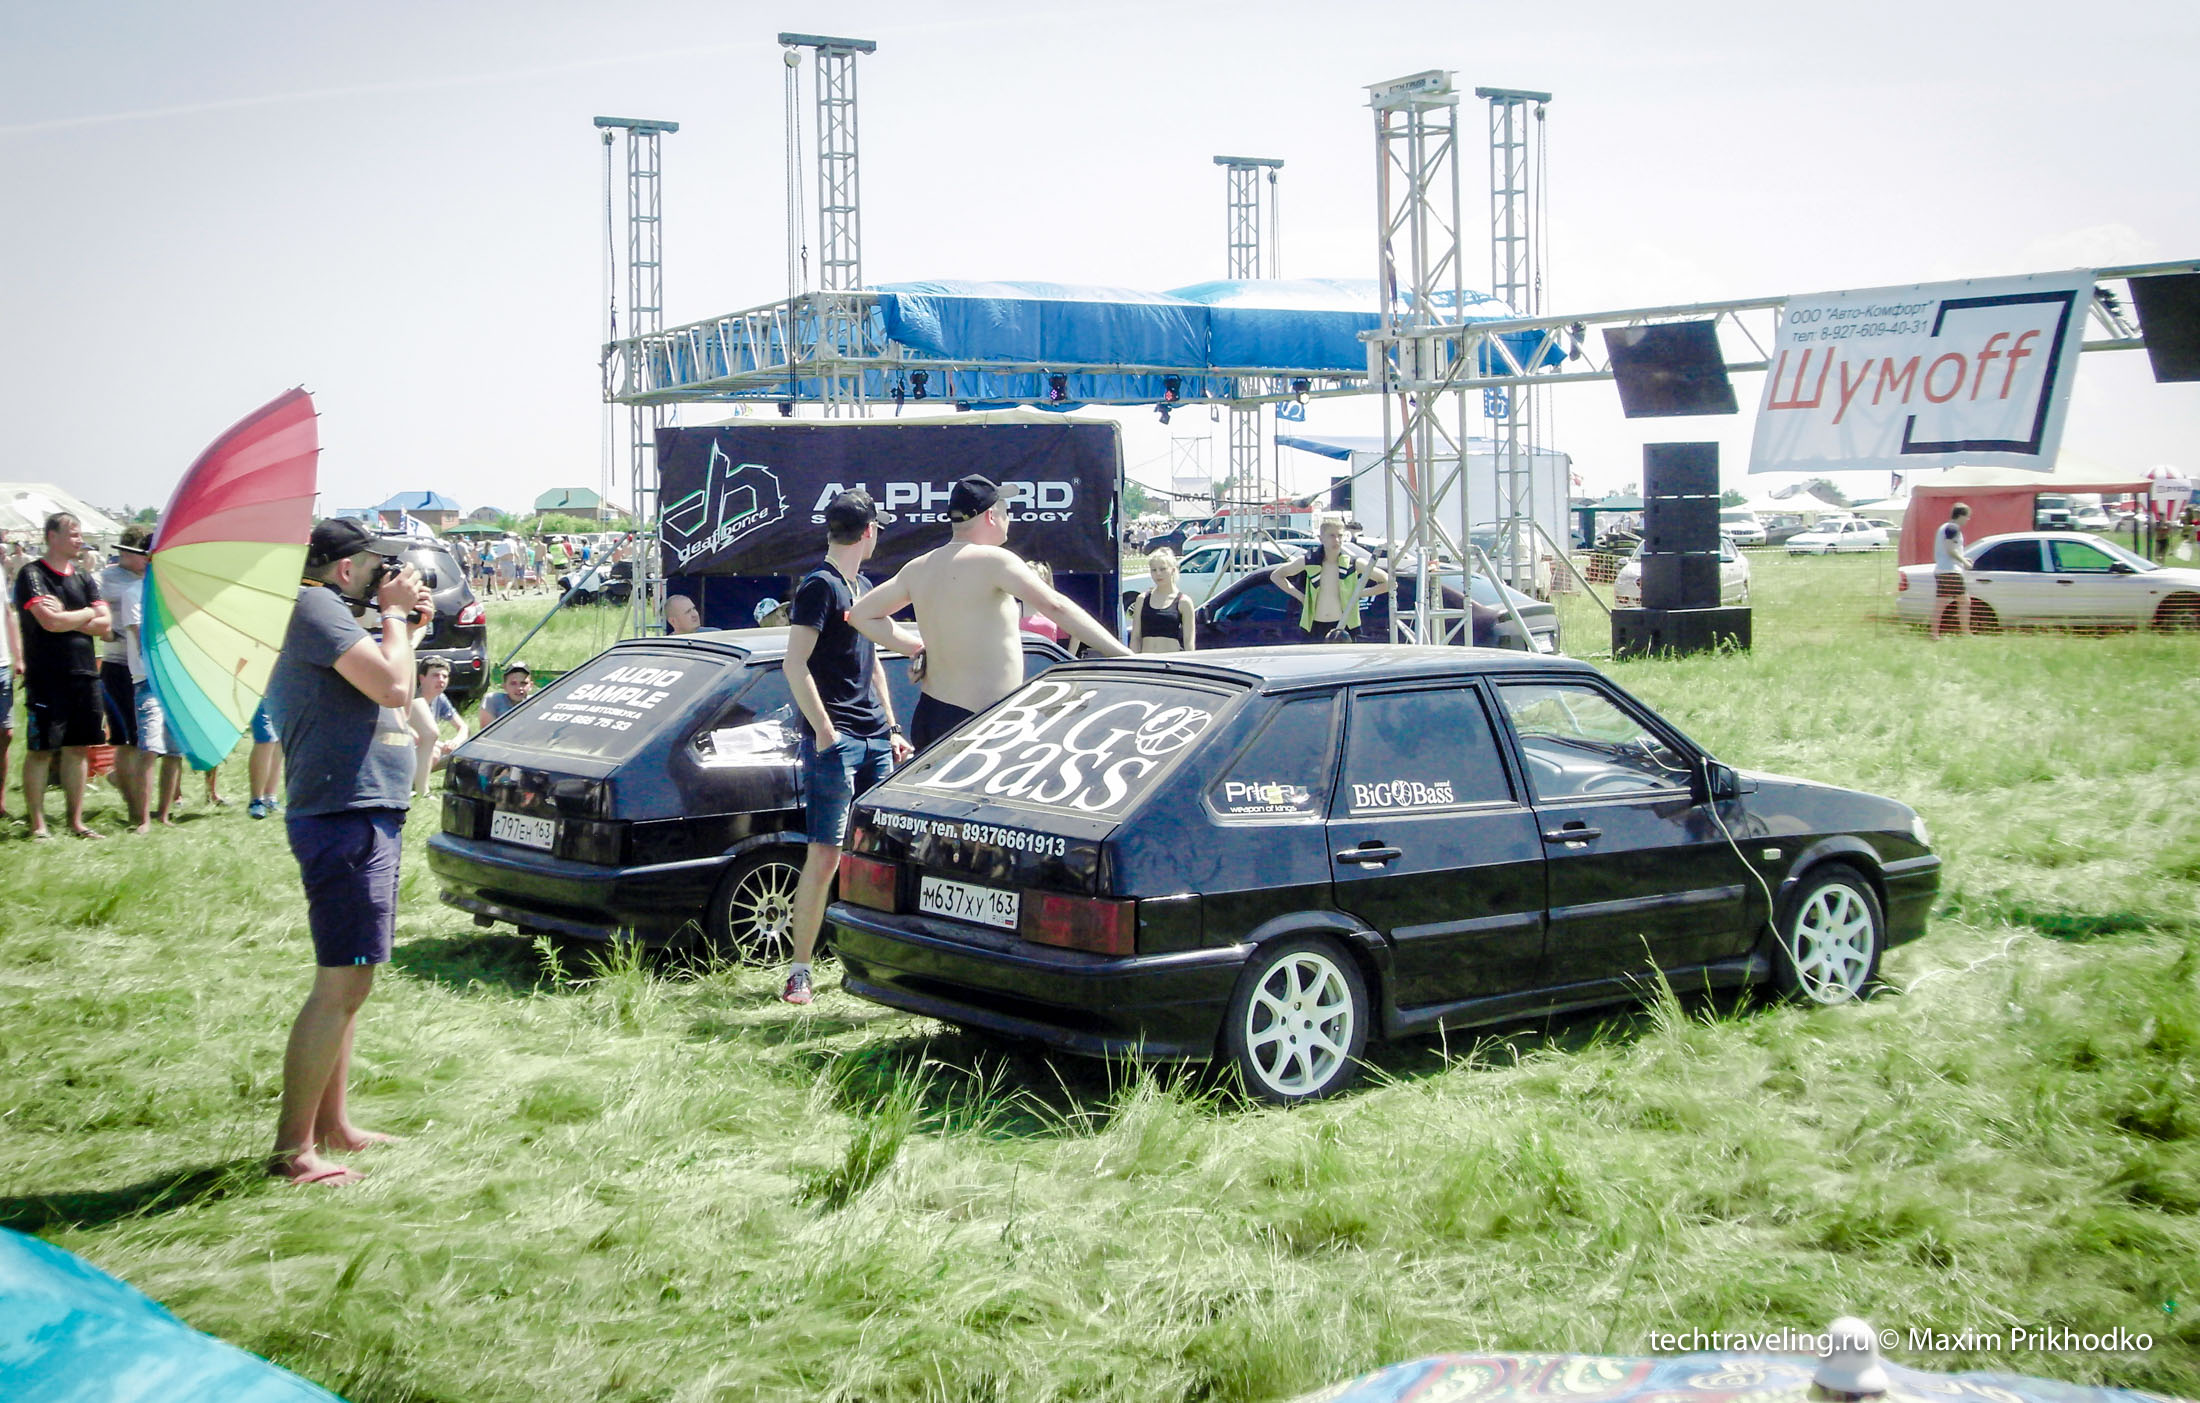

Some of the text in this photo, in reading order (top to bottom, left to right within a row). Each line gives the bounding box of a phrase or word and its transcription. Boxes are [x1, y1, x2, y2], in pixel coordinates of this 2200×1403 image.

[1790, 308, 1822, 325] ООО
[1820, 320, 1928, 341] 8-927-609-40-31
[813, 481, 1074, 512] APHRD
[905, 511, 1074, 523] TECLOGY
[600, 666, 684, 688] AUDIO
[566, 684, 670, 709] SAMPLE
[914, 720, 1159, 811] Bass
[1352, 782, 1454, 807] BiG Bass
[1230, 805, 1265, 813] weapon
[1265, 804, 1275, 812] of
[535, 821, 551, 839] 163
[872, 808, 1066, 857] Автозвук тел. 89376661913
[989, 892, 1013, 915] 163
